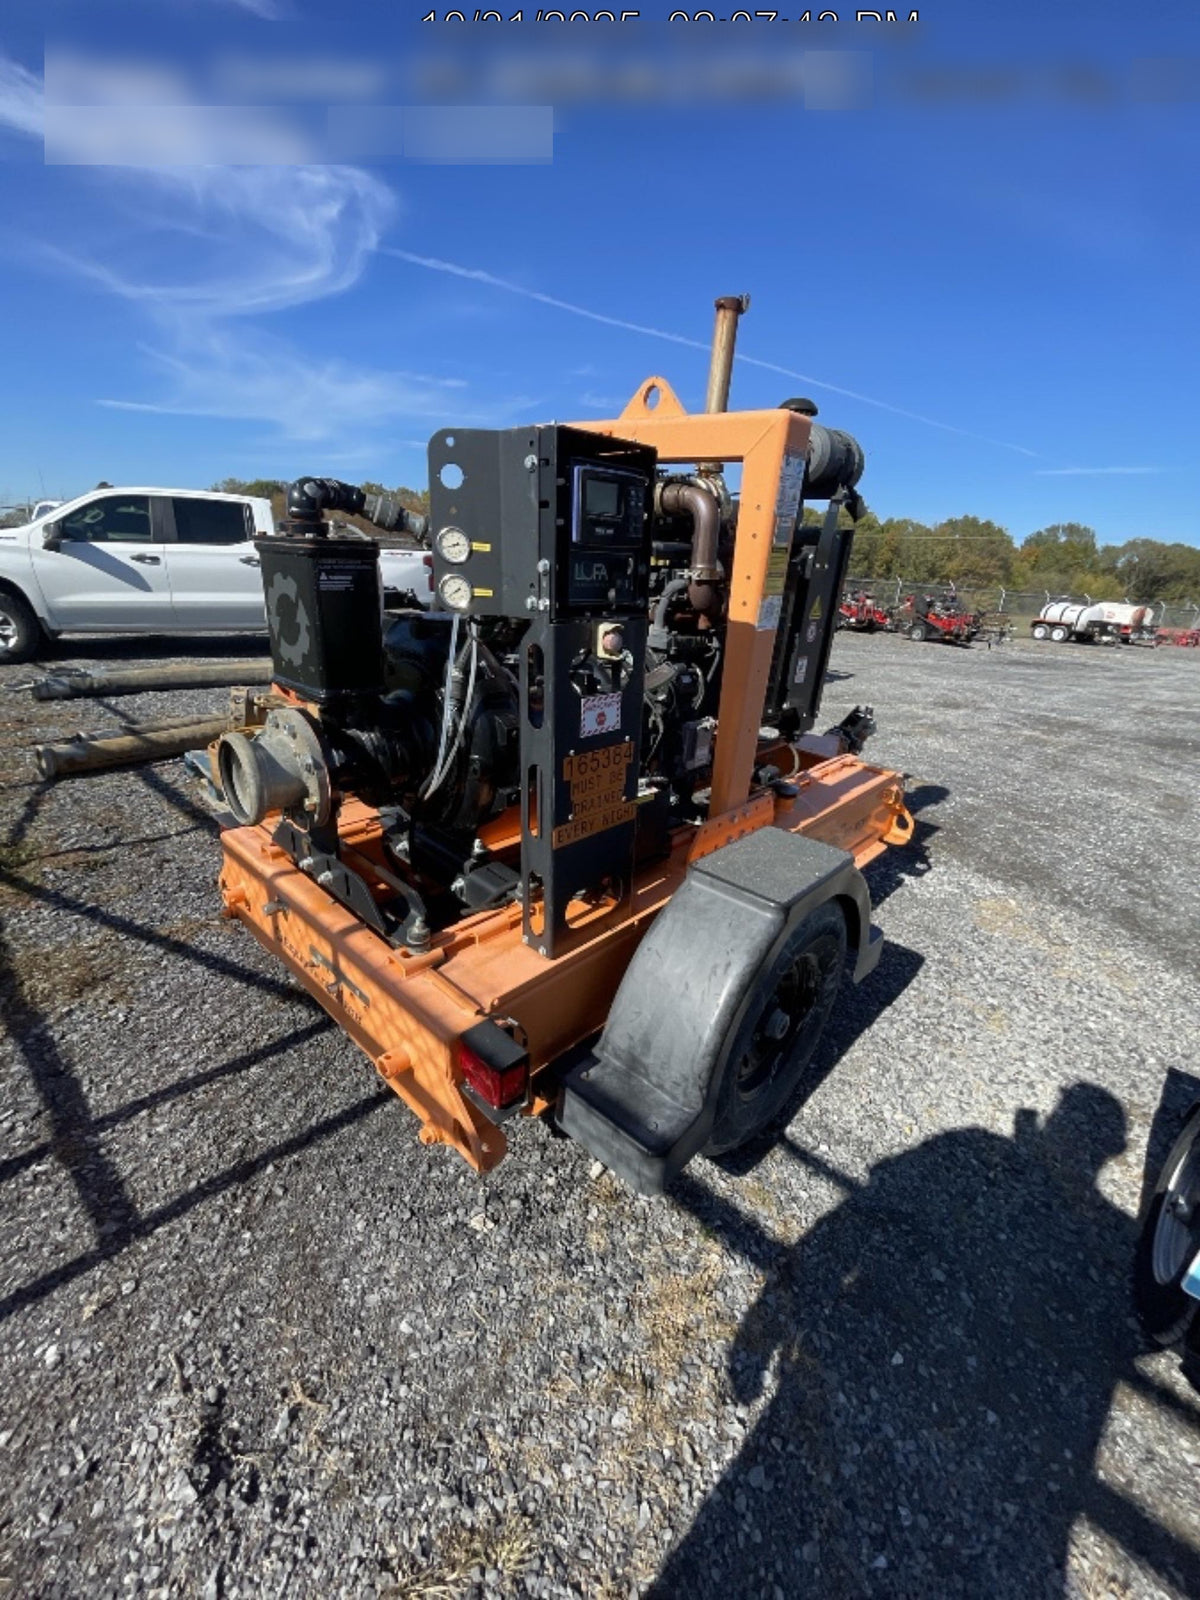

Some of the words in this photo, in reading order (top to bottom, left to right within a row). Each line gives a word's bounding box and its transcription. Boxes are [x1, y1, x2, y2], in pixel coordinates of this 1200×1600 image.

[566, 743, 632, 777] 165384
[572, 775, 602, 797] MUST
[609, 768, 623, 784] BE
[557, 818, 595, 843] EVERY
